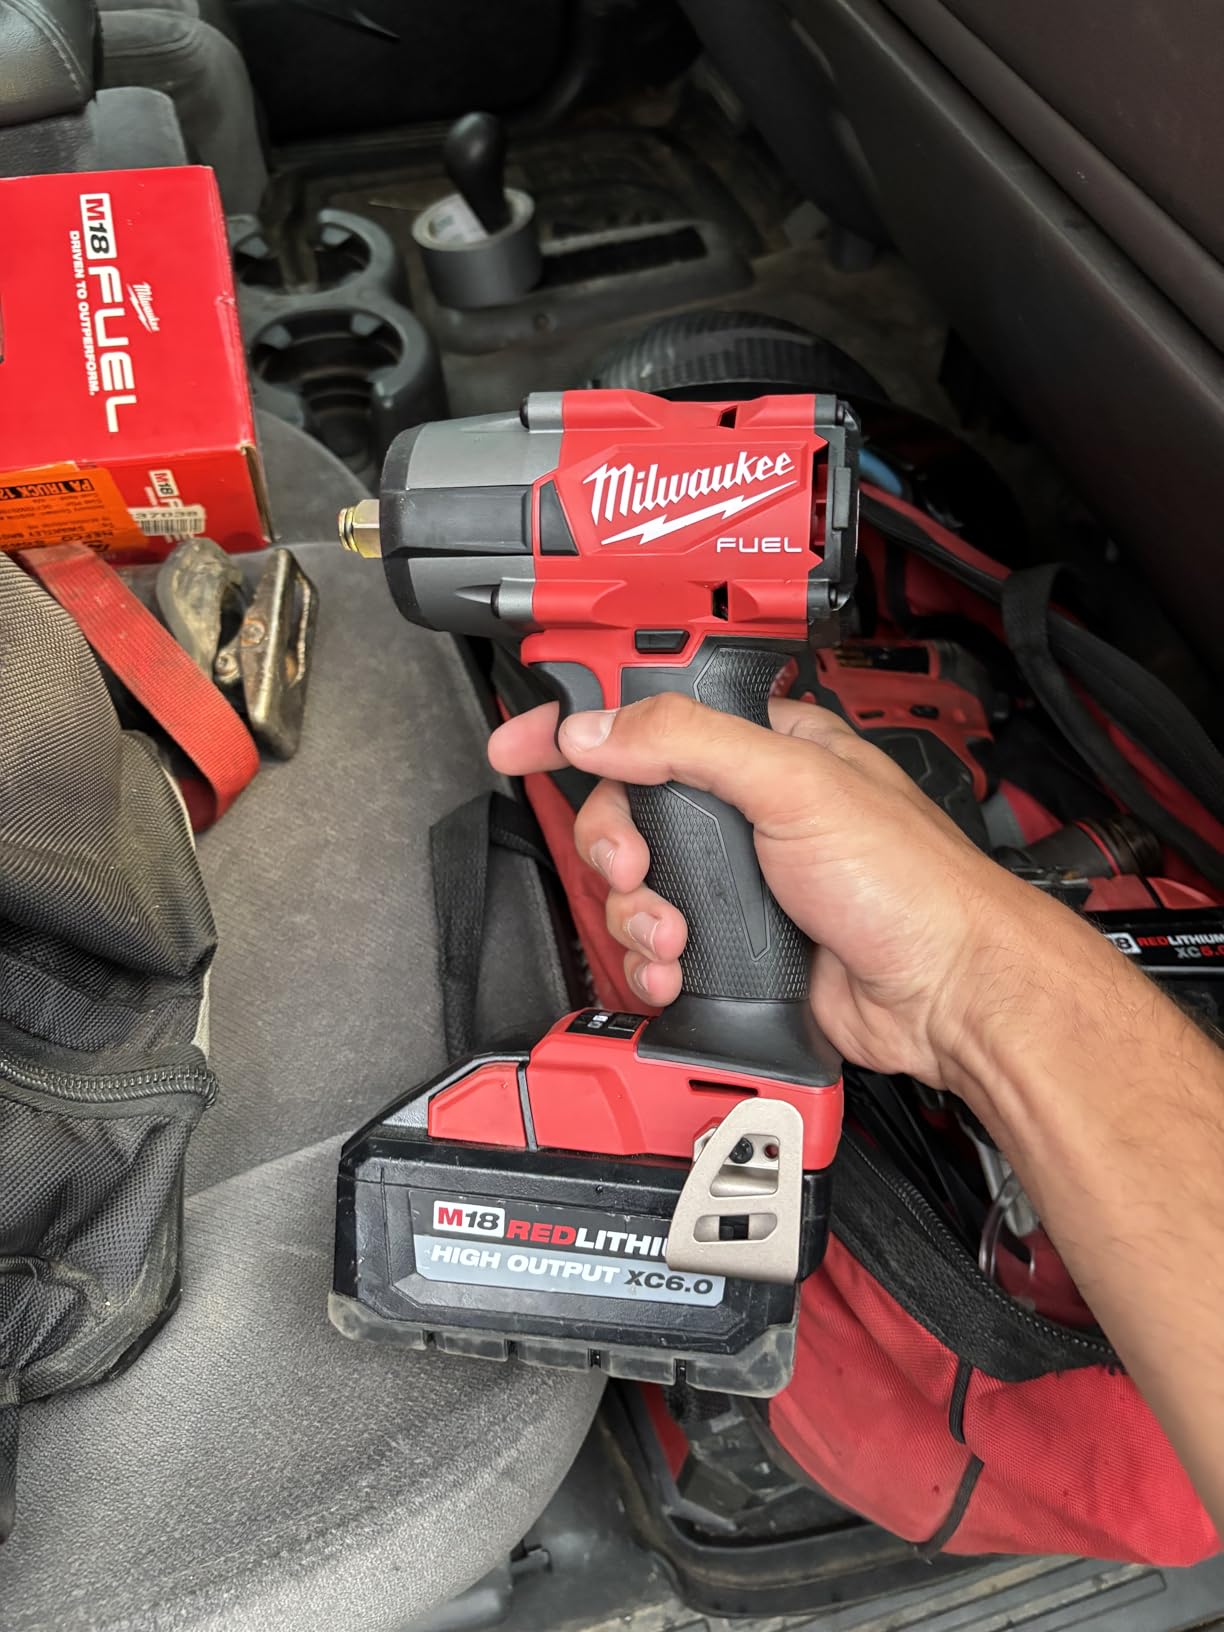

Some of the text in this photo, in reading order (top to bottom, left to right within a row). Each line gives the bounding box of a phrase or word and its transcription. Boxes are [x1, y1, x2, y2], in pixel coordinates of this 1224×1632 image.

[69, 230, 100, 396] DRIVEN TO OUTPERFORM.
[84, 197, 137, 433] M18 FUEL
[132, 281, 160, 332] Milwaukee
[16, 481, 67, 498] TRUCK
[69, 478, 93, 492] PA
[153, 471, 175, 496] M18
[582, 450, 796, 527] Milwaukee
[716, 536, 803, 554] FUEL
[436, 1205, 502, 1232] M18
[430, 1244, 714, 1295] HIGH OUTPUT XC6.0
